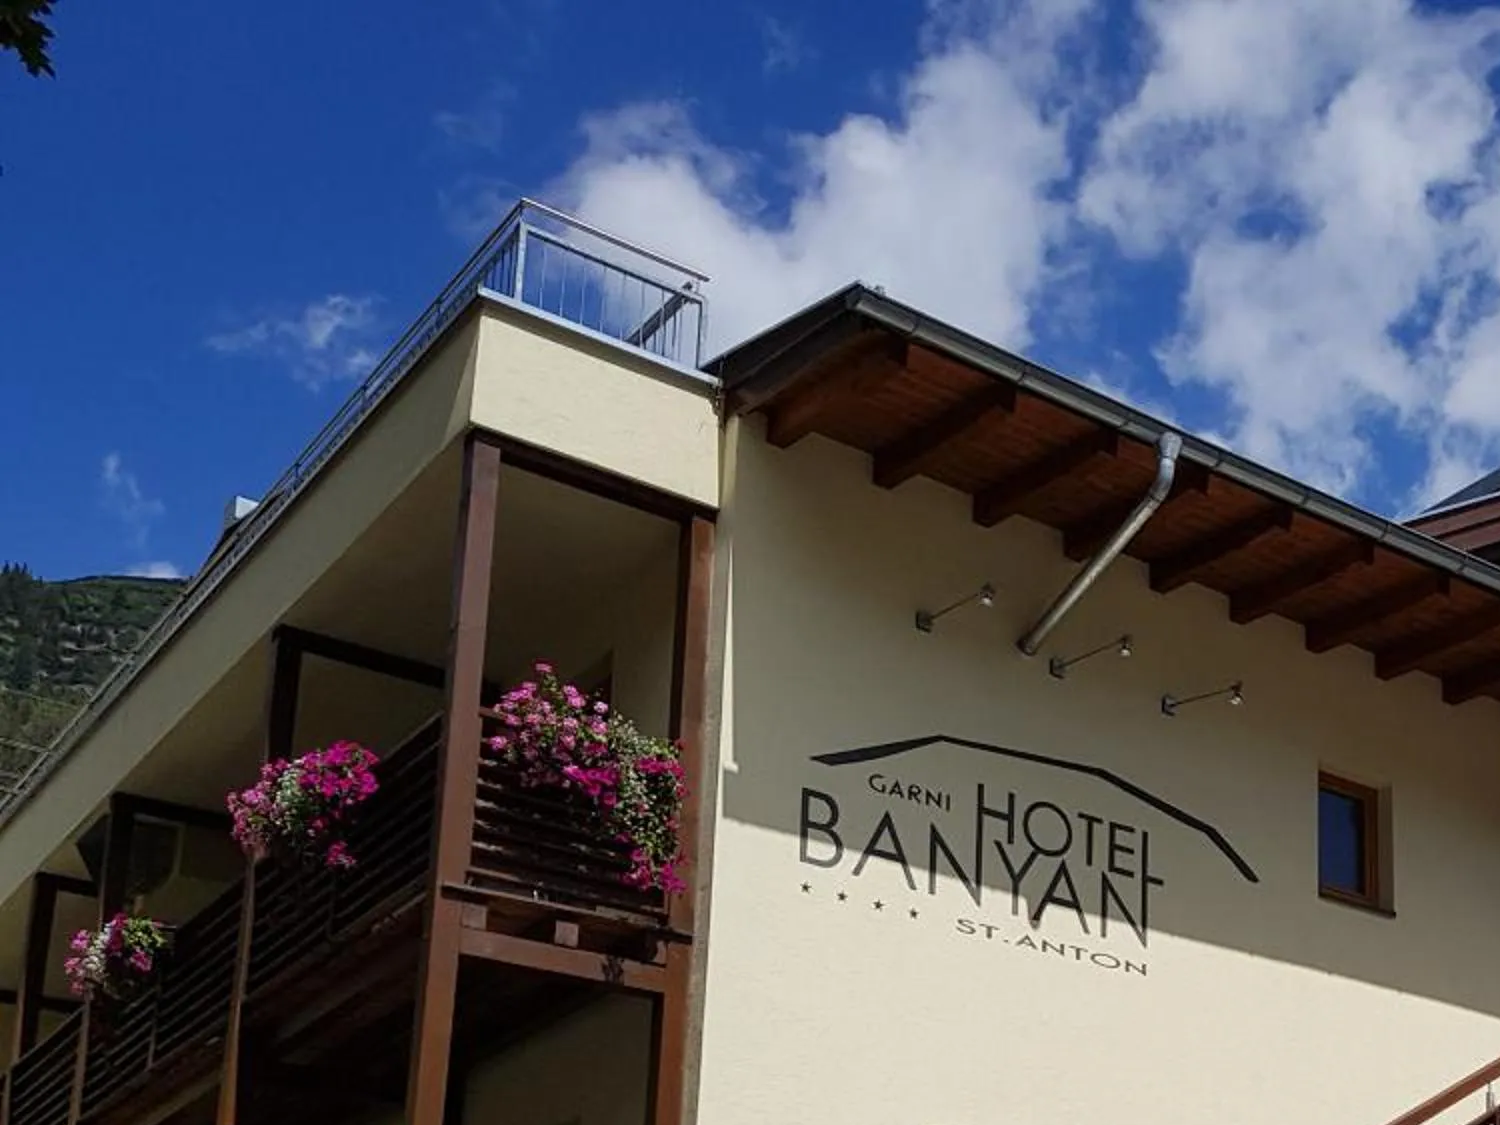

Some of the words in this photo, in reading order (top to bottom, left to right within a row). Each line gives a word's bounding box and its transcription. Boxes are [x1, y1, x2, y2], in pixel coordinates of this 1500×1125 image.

[867, 773, 951, 813] GARNI
[976, 783, 1164, 888] HOTEL
[799, 787, 1149, 949] BANYAN
